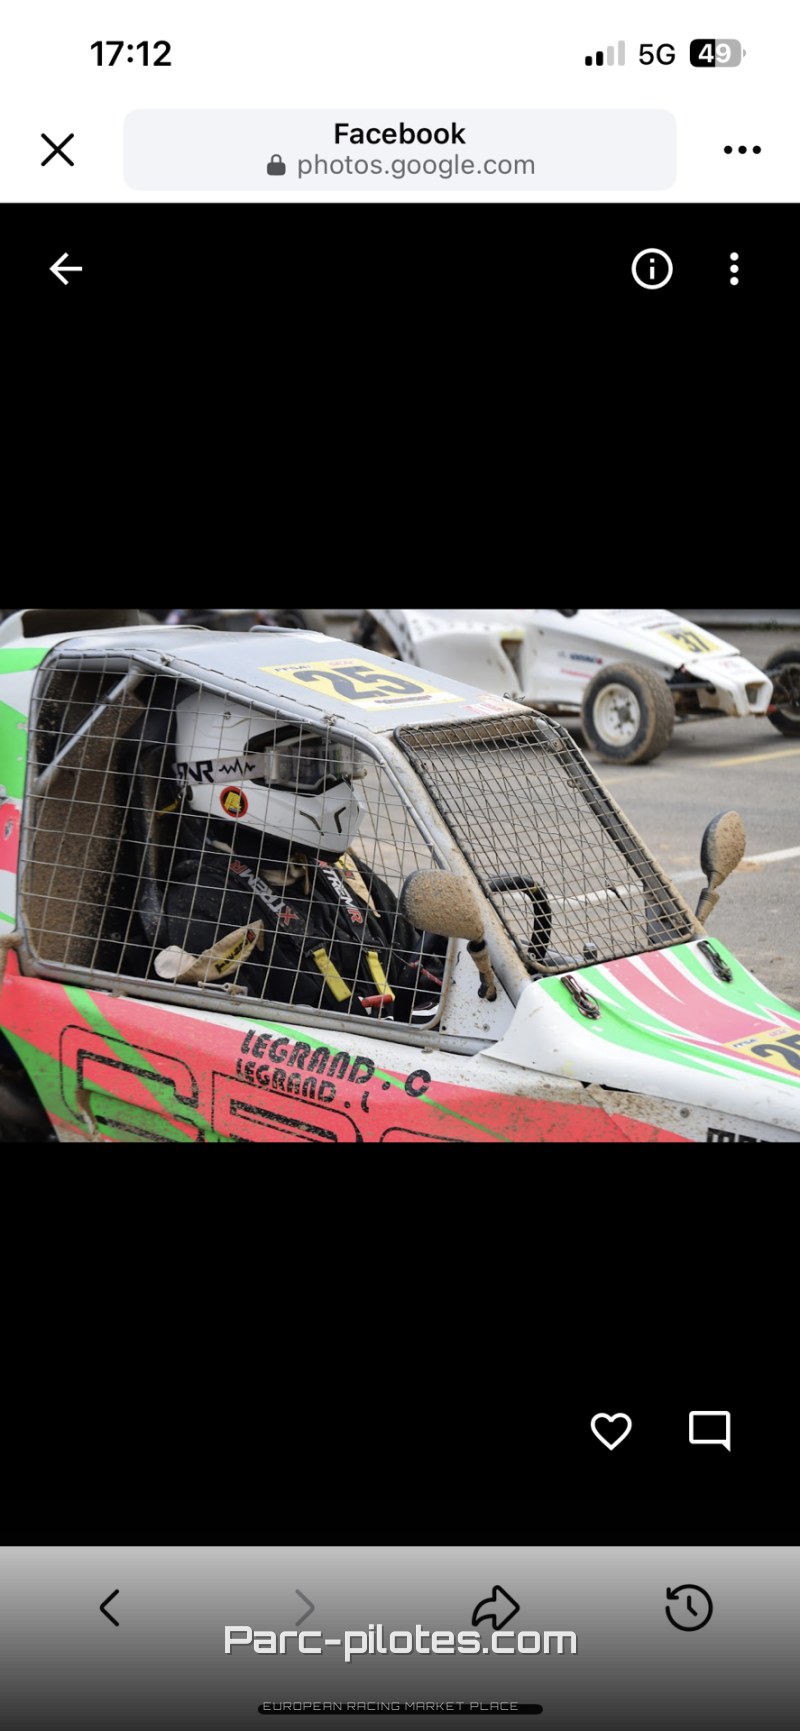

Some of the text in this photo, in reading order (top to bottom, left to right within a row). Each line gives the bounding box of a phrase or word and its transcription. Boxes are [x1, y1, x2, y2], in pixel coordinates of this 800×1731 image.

[91, 41, 171, 66] 17:12
[639, 43, 676, 65] 5G
[698, 43, 731, 63] 49
[334, 121, 466, 145] Facebook
[298, 153, 535, 180] photos.google.com
[672, 631, 710, 652] 37
[293, 665, 425, 699] 25
[404, 1069, 431, 1098] C
